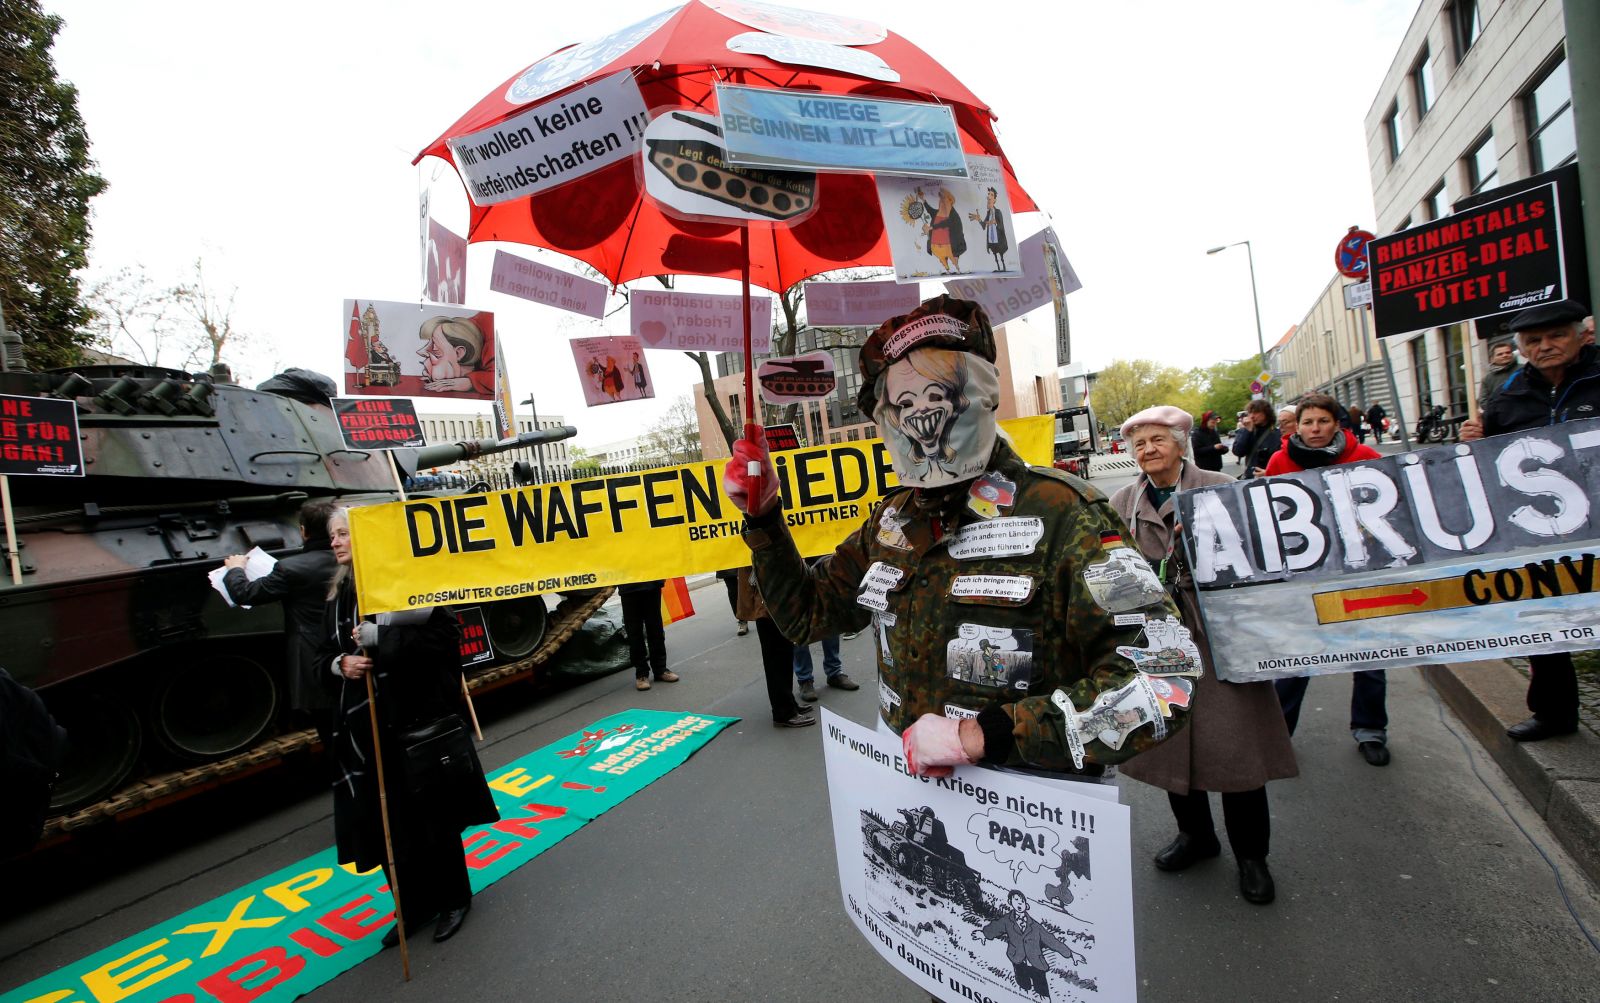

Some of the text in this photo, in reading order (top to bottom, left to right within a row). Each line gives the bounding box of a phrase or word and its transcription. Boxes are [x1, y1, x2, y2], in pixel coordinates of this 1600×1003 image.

[798, 99, 881, 123] KRIEGE
[457, 96, 603, 166] Wir wollen keine
[723, 113, 959, 150] BEGINNEN MIT LÜGEN
[680, 145, 703, 161] Legt
[707, 155, 725, 168] den
[1377, 200, 1546, 265] RHEINMETALLS
[1379, 228, 1549, 292] PANZER-DEAL
[924, 328, 938, 337] den
[354, 400, 394, 412] KEINE
[340, 414, 390, 428] PANZER
[404, 496, 496, 558] DIE
[500, 465, 722, 547] WAFFEN
[787, 504, 859, 527] SUTTNER
[978, 522, 999, 530] Kinder
[979, 531, 1007, 540] anderen
[1008, 530, 1039, 538] Ländern
[960, 548, 970, 556] den
[971, 546, 987, 554] Krieg
[494, 584, 535, 597] GEGEN
[537, 578, 561, 591] DEN
[564, 573, 597, 587] KRIEG
[867, 585, 886, 596] Kinder
[983, 577, 1005, 585] bringe
[1463, 553, 1596, 605] CONV
[982, 587, 993, 595] die
[1257, 627, 1594, 670] MONTAGSMAHNWACHE BRANDENBURGER TOR
[945, 706, 964, 718] Weg
[828, 723, 847, 744] Wir
[848, 737, 890, 767] wollen
[1006, 795, 1063, 826] nicht
[1071, 809, 1095, 834] !!!
[988, 820, 1045, 857] PAPA!
[848, 893, 863, 919] Sie
[864, 912, 894, 951] töten
[897, 942, 944, 984] damit
